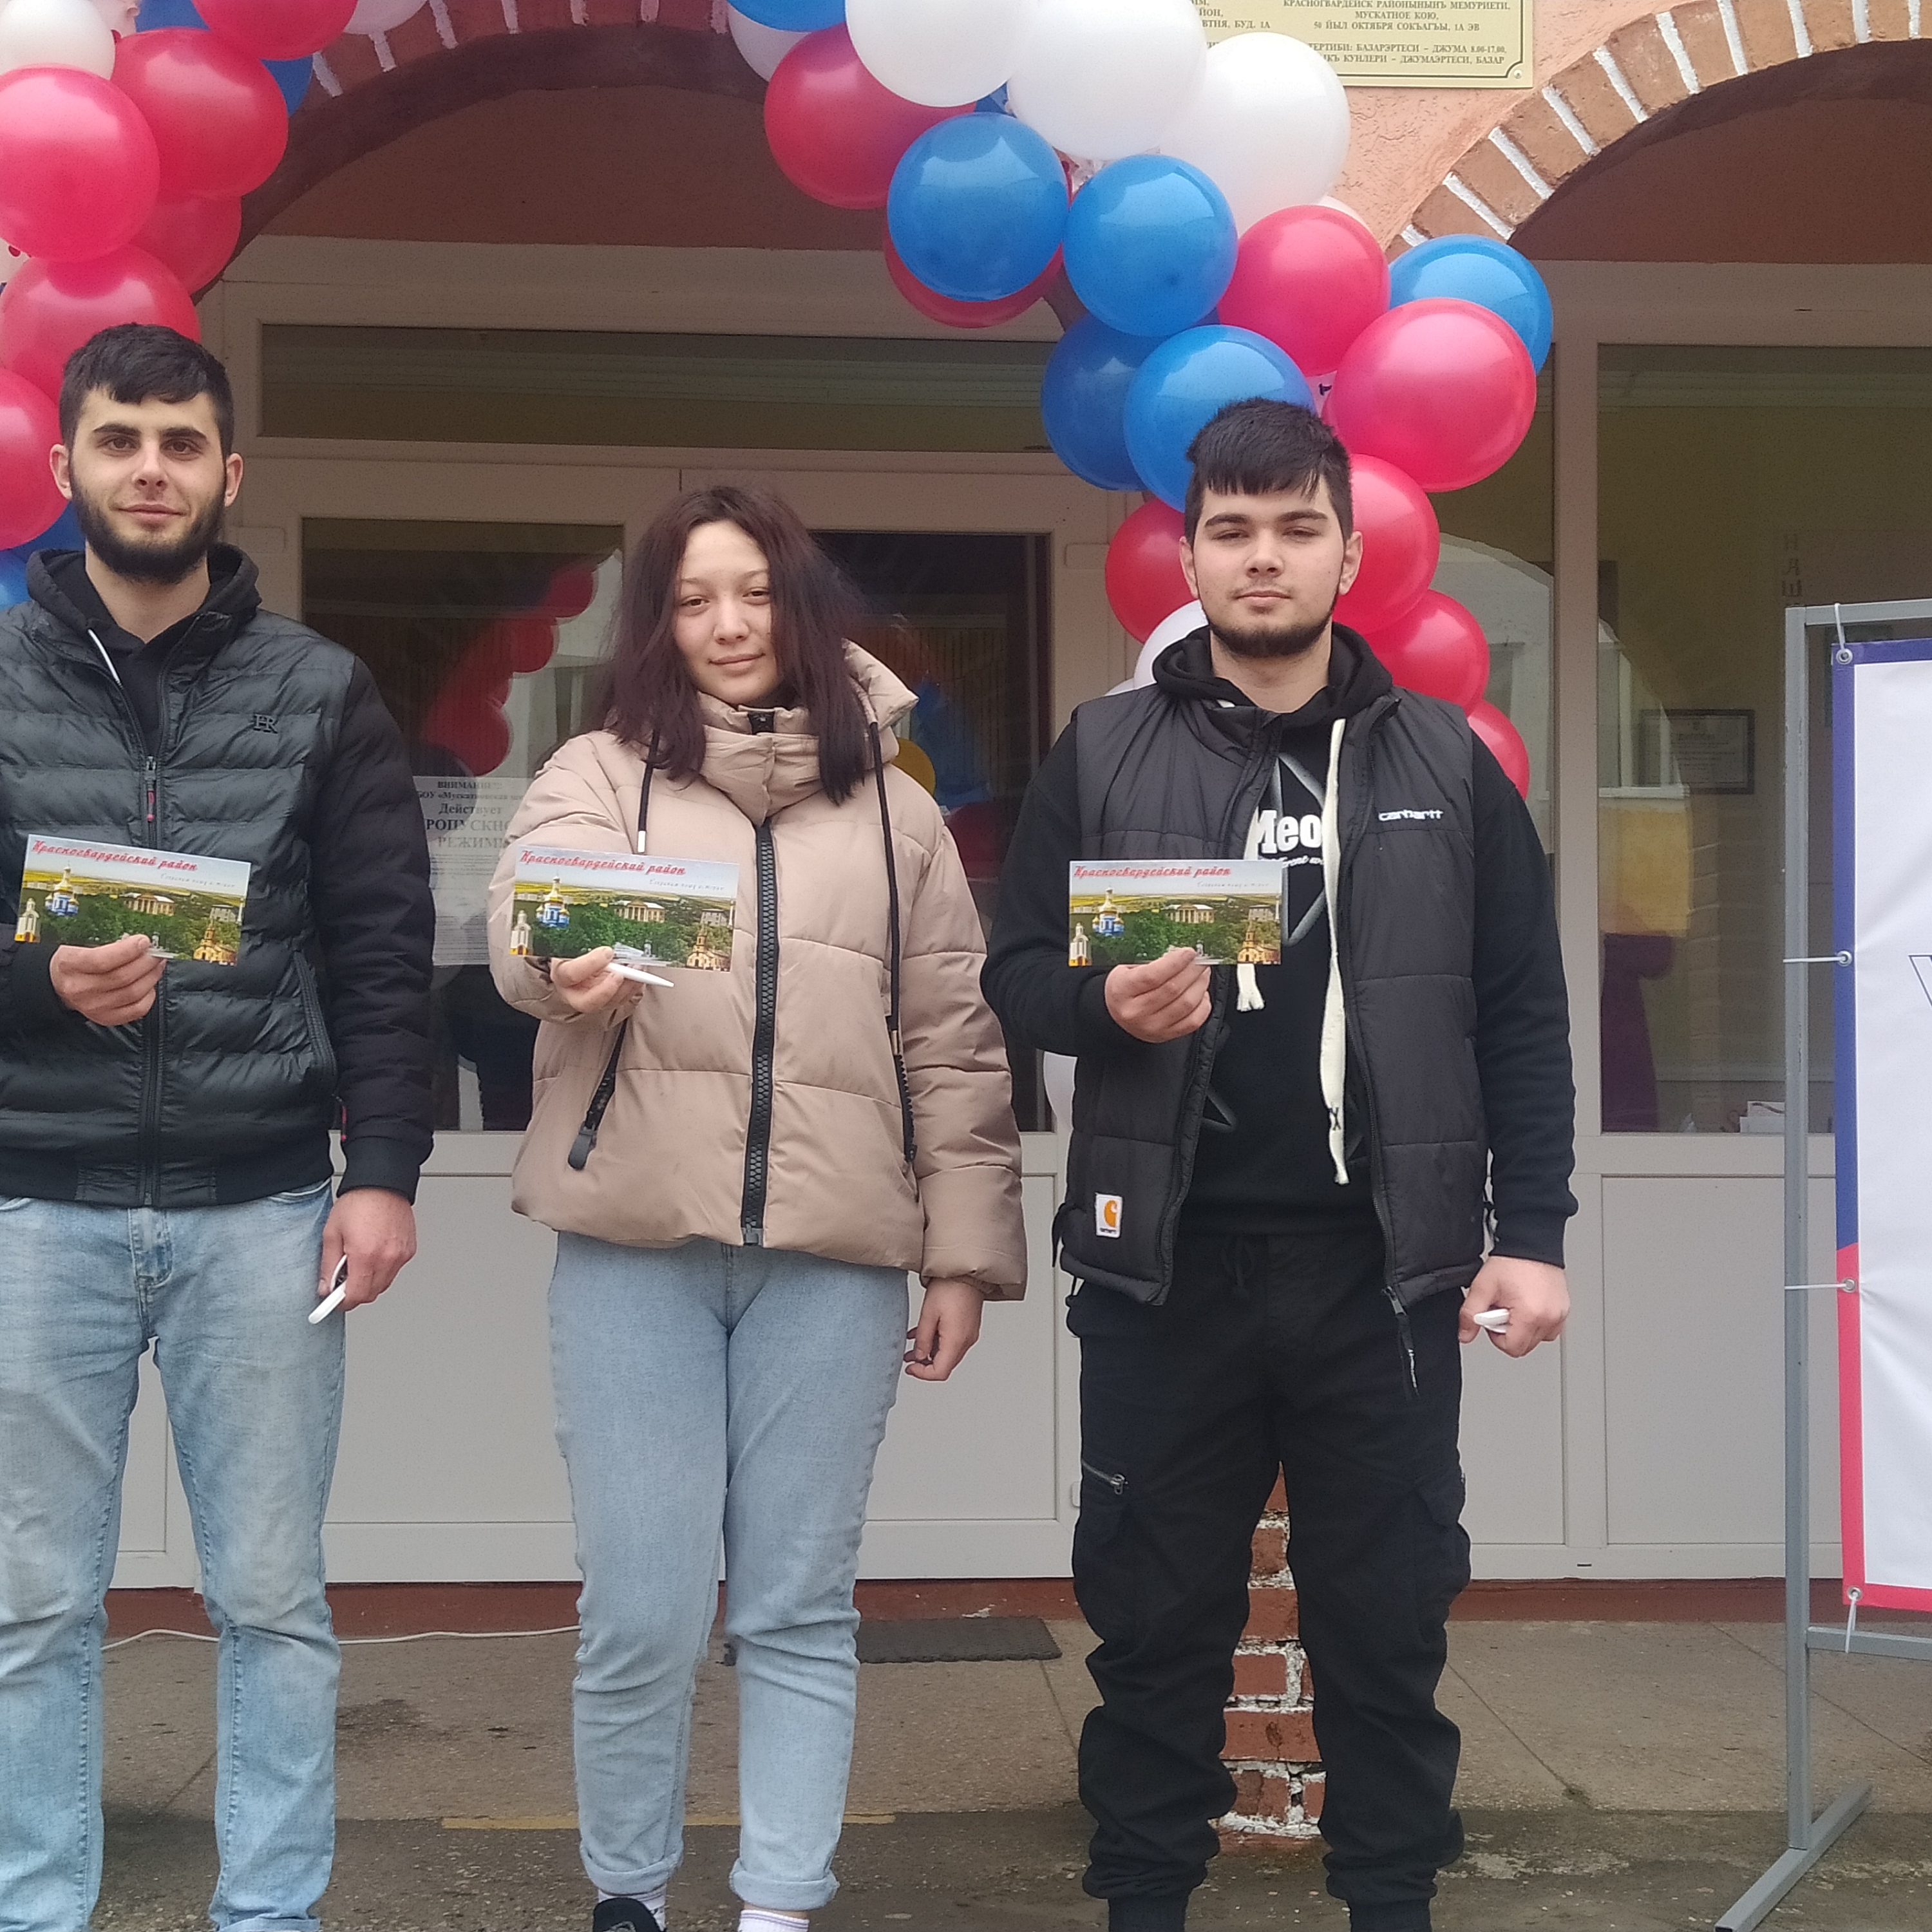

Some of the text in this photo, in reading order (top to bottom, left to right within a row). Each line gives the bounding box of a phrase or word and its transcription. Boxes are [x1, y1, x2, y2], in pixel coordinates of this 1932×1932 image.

[1198, 6, 1224, 17] ЙОН,
[1355, 11, 1410, 19] МУСКАТНОЕ
[1202, 19, 1231, 28] ВТНЯ,
[438, 803, 502, 816] Действует
[32, 840, 198, 871] Красногвардейский район
[520, 849, 686, 875] Красногвардейский район
[1074, 865, 1231, 879] Красногвардейский район
